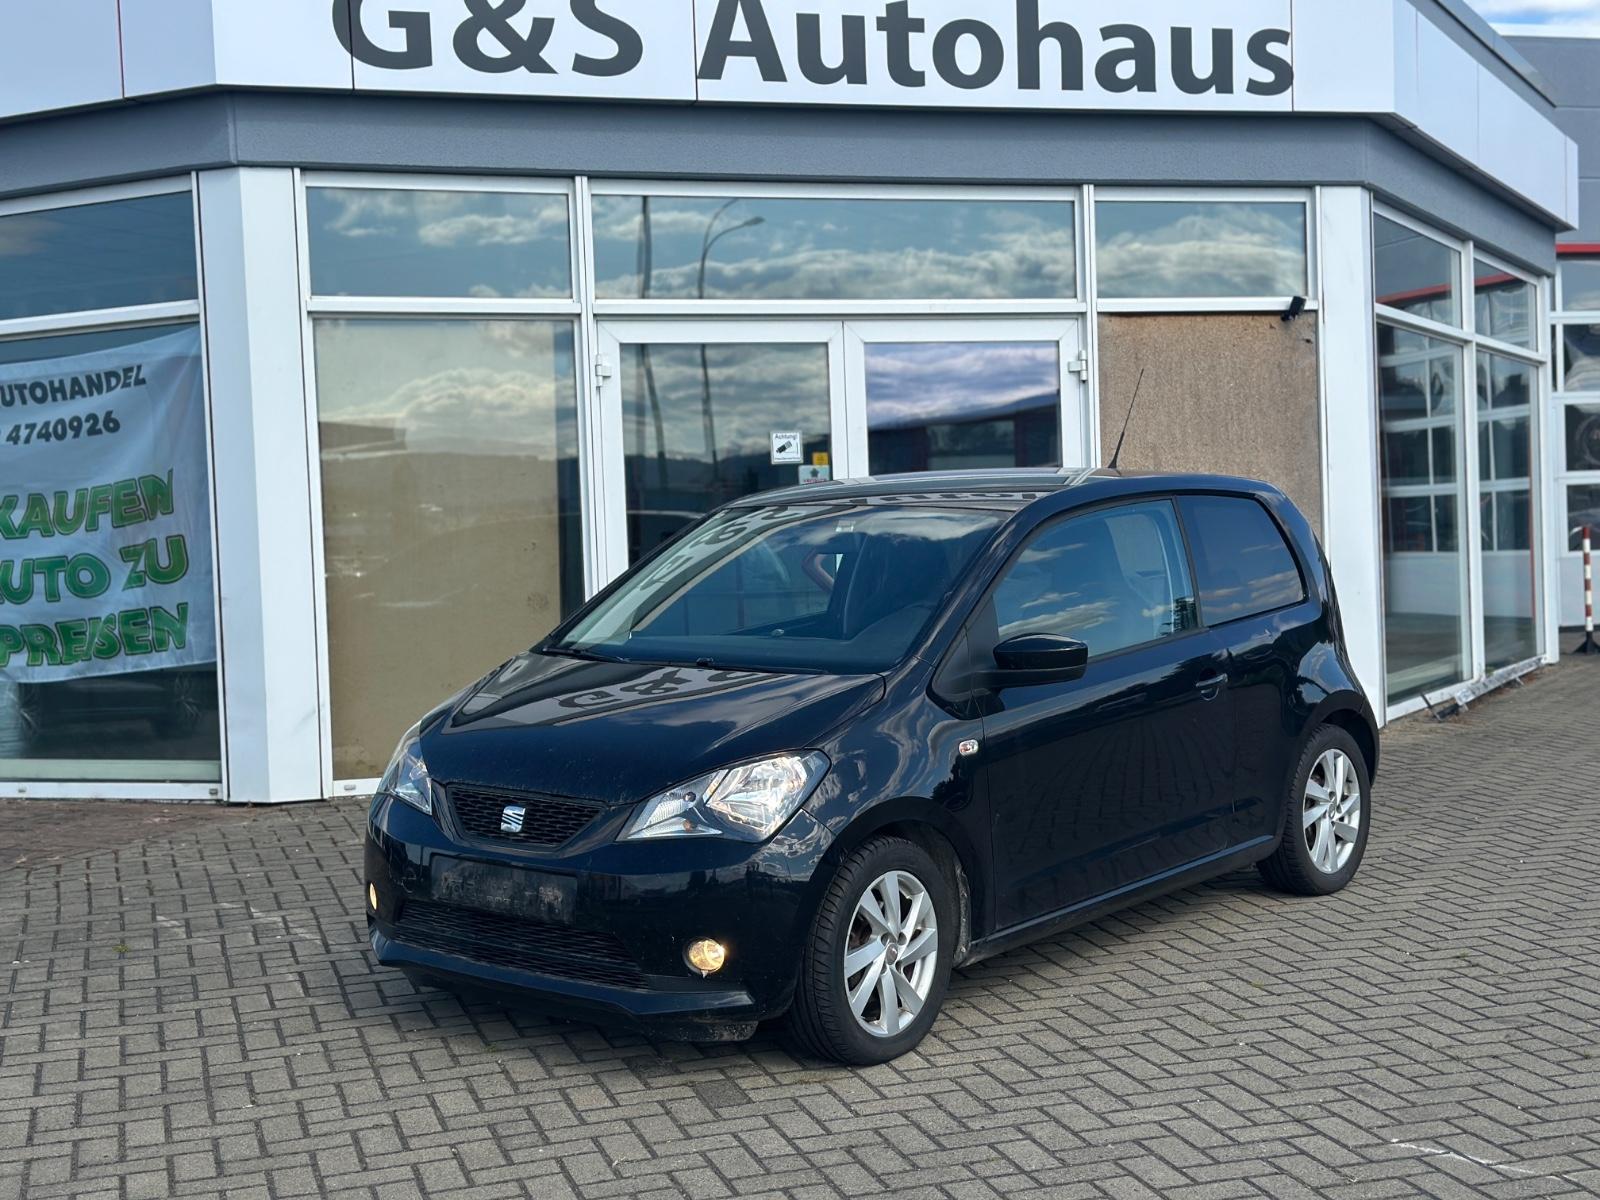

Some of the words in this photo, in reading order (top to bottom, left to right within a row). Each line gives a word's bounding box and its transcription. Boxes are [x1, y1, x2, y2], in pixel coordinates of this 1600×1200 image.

[332, 0, 643, 77] G&S
[697, 0, 1294, 95] Autohaus
[6, 411, 120, 445] 4740926
[0, 553, 111, 605] UTO
[119, 534, 189, 591] ZU
[0, 602, 189, 666] PREISEN
